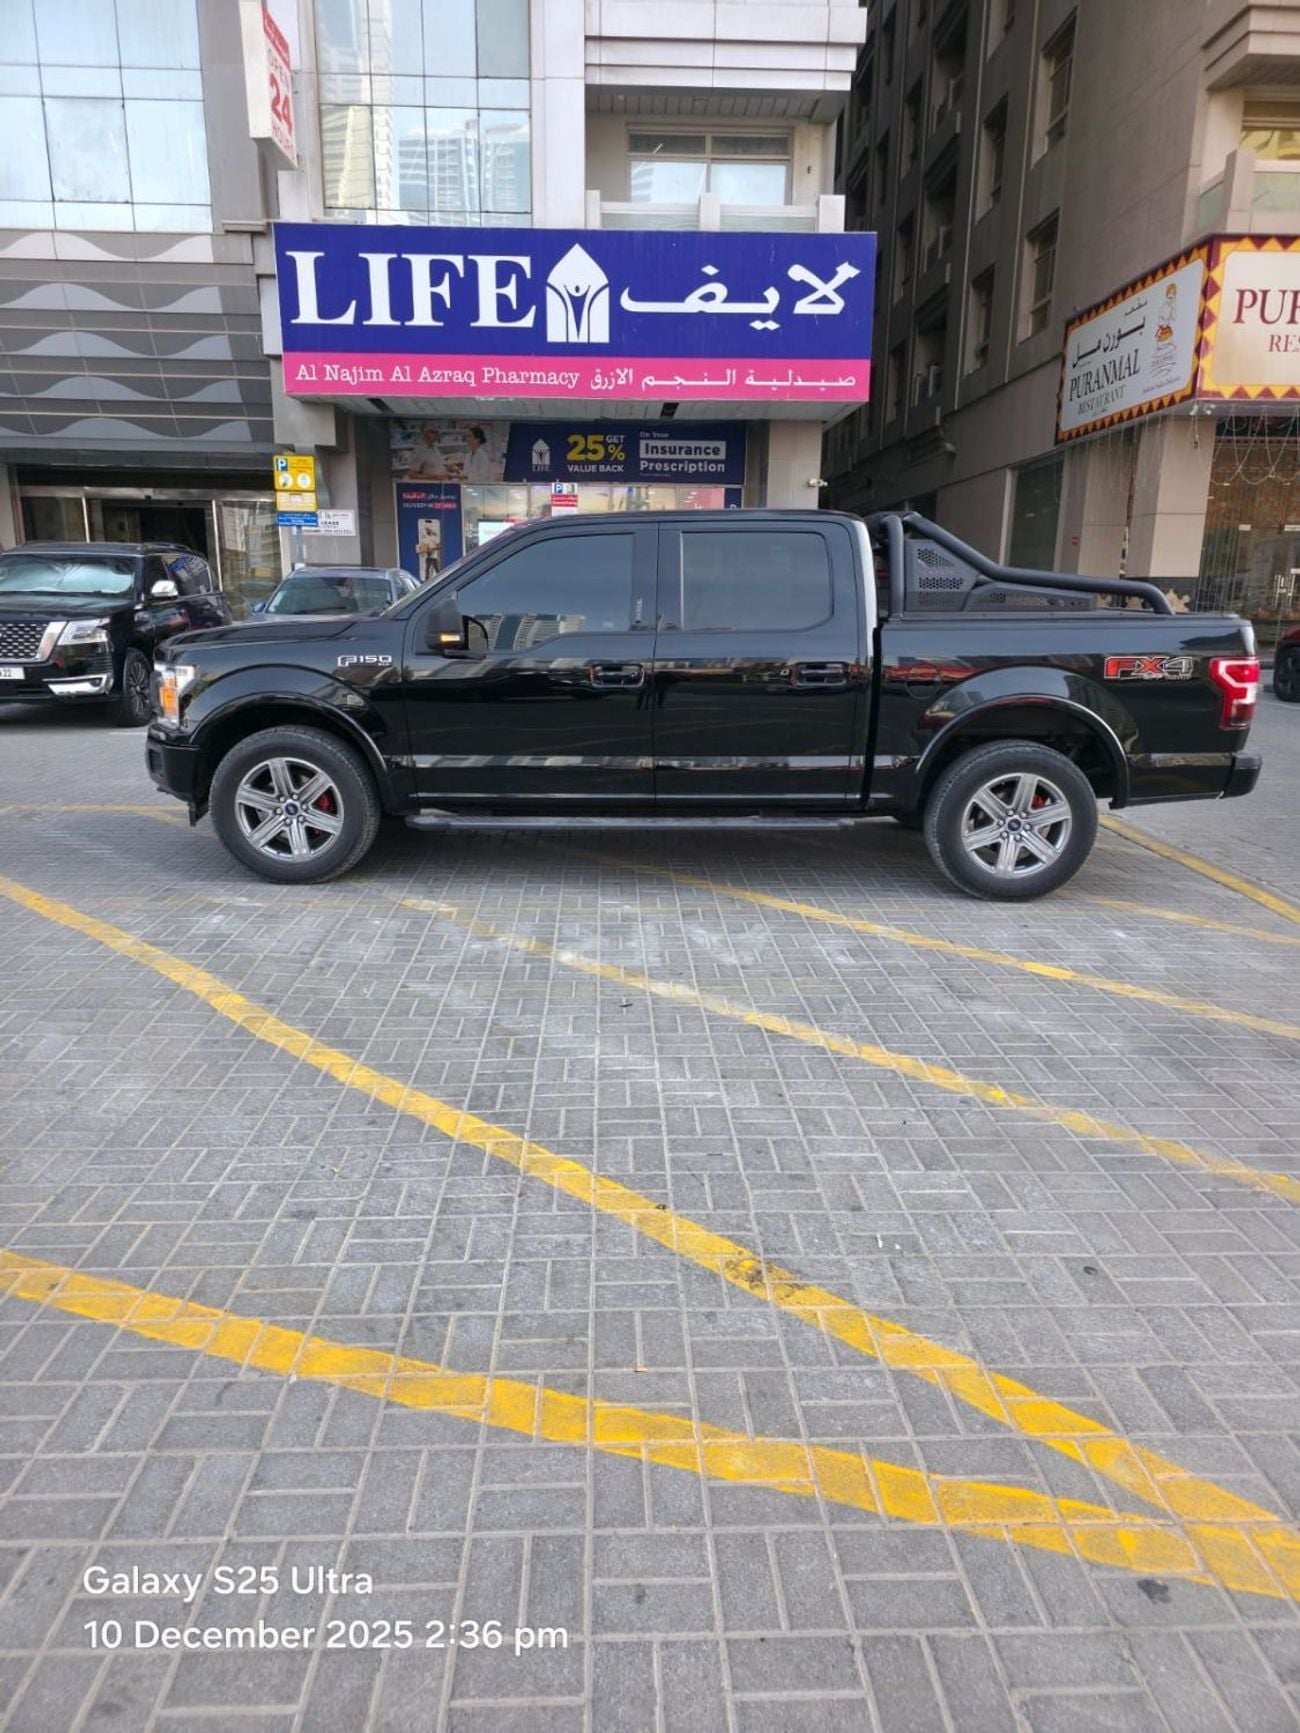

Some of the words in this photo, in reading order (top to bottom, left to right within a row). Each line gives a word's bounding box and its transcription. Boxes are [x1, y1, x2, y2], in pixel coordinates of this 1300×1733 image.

[270, 73, 292, 136] 24
[286, 251, 536, 328] LIFE
[620, 261, 860, 330] لايف
[295, 364, 317, 380] Al
[323, 365, 384, 386] Najim
[390, 366, 411, 382] Al
[418, 366, 477, 387] Azraq
[482, 367, 580, 389] Pharmacy
[590, 367, 633, 390] الازرق
[641, 369, 737, 392] النجم
[745, 369, 856, 392] صيدلية
[1069, 349, 1141, 402] PURANMAL
[1077, 384, 1127, 415] RESTAURANT
[605, 435, 625, 443] GET
[645, 442, 720, 456] Insurance
[277, 458, 287, 471] P
[568, 464, 597, 473] VALUE
[599, 464, 624, 473] BACK
[640, 460, 725, 473] Prescription
[1104, 656, 1193, 679] FX4
